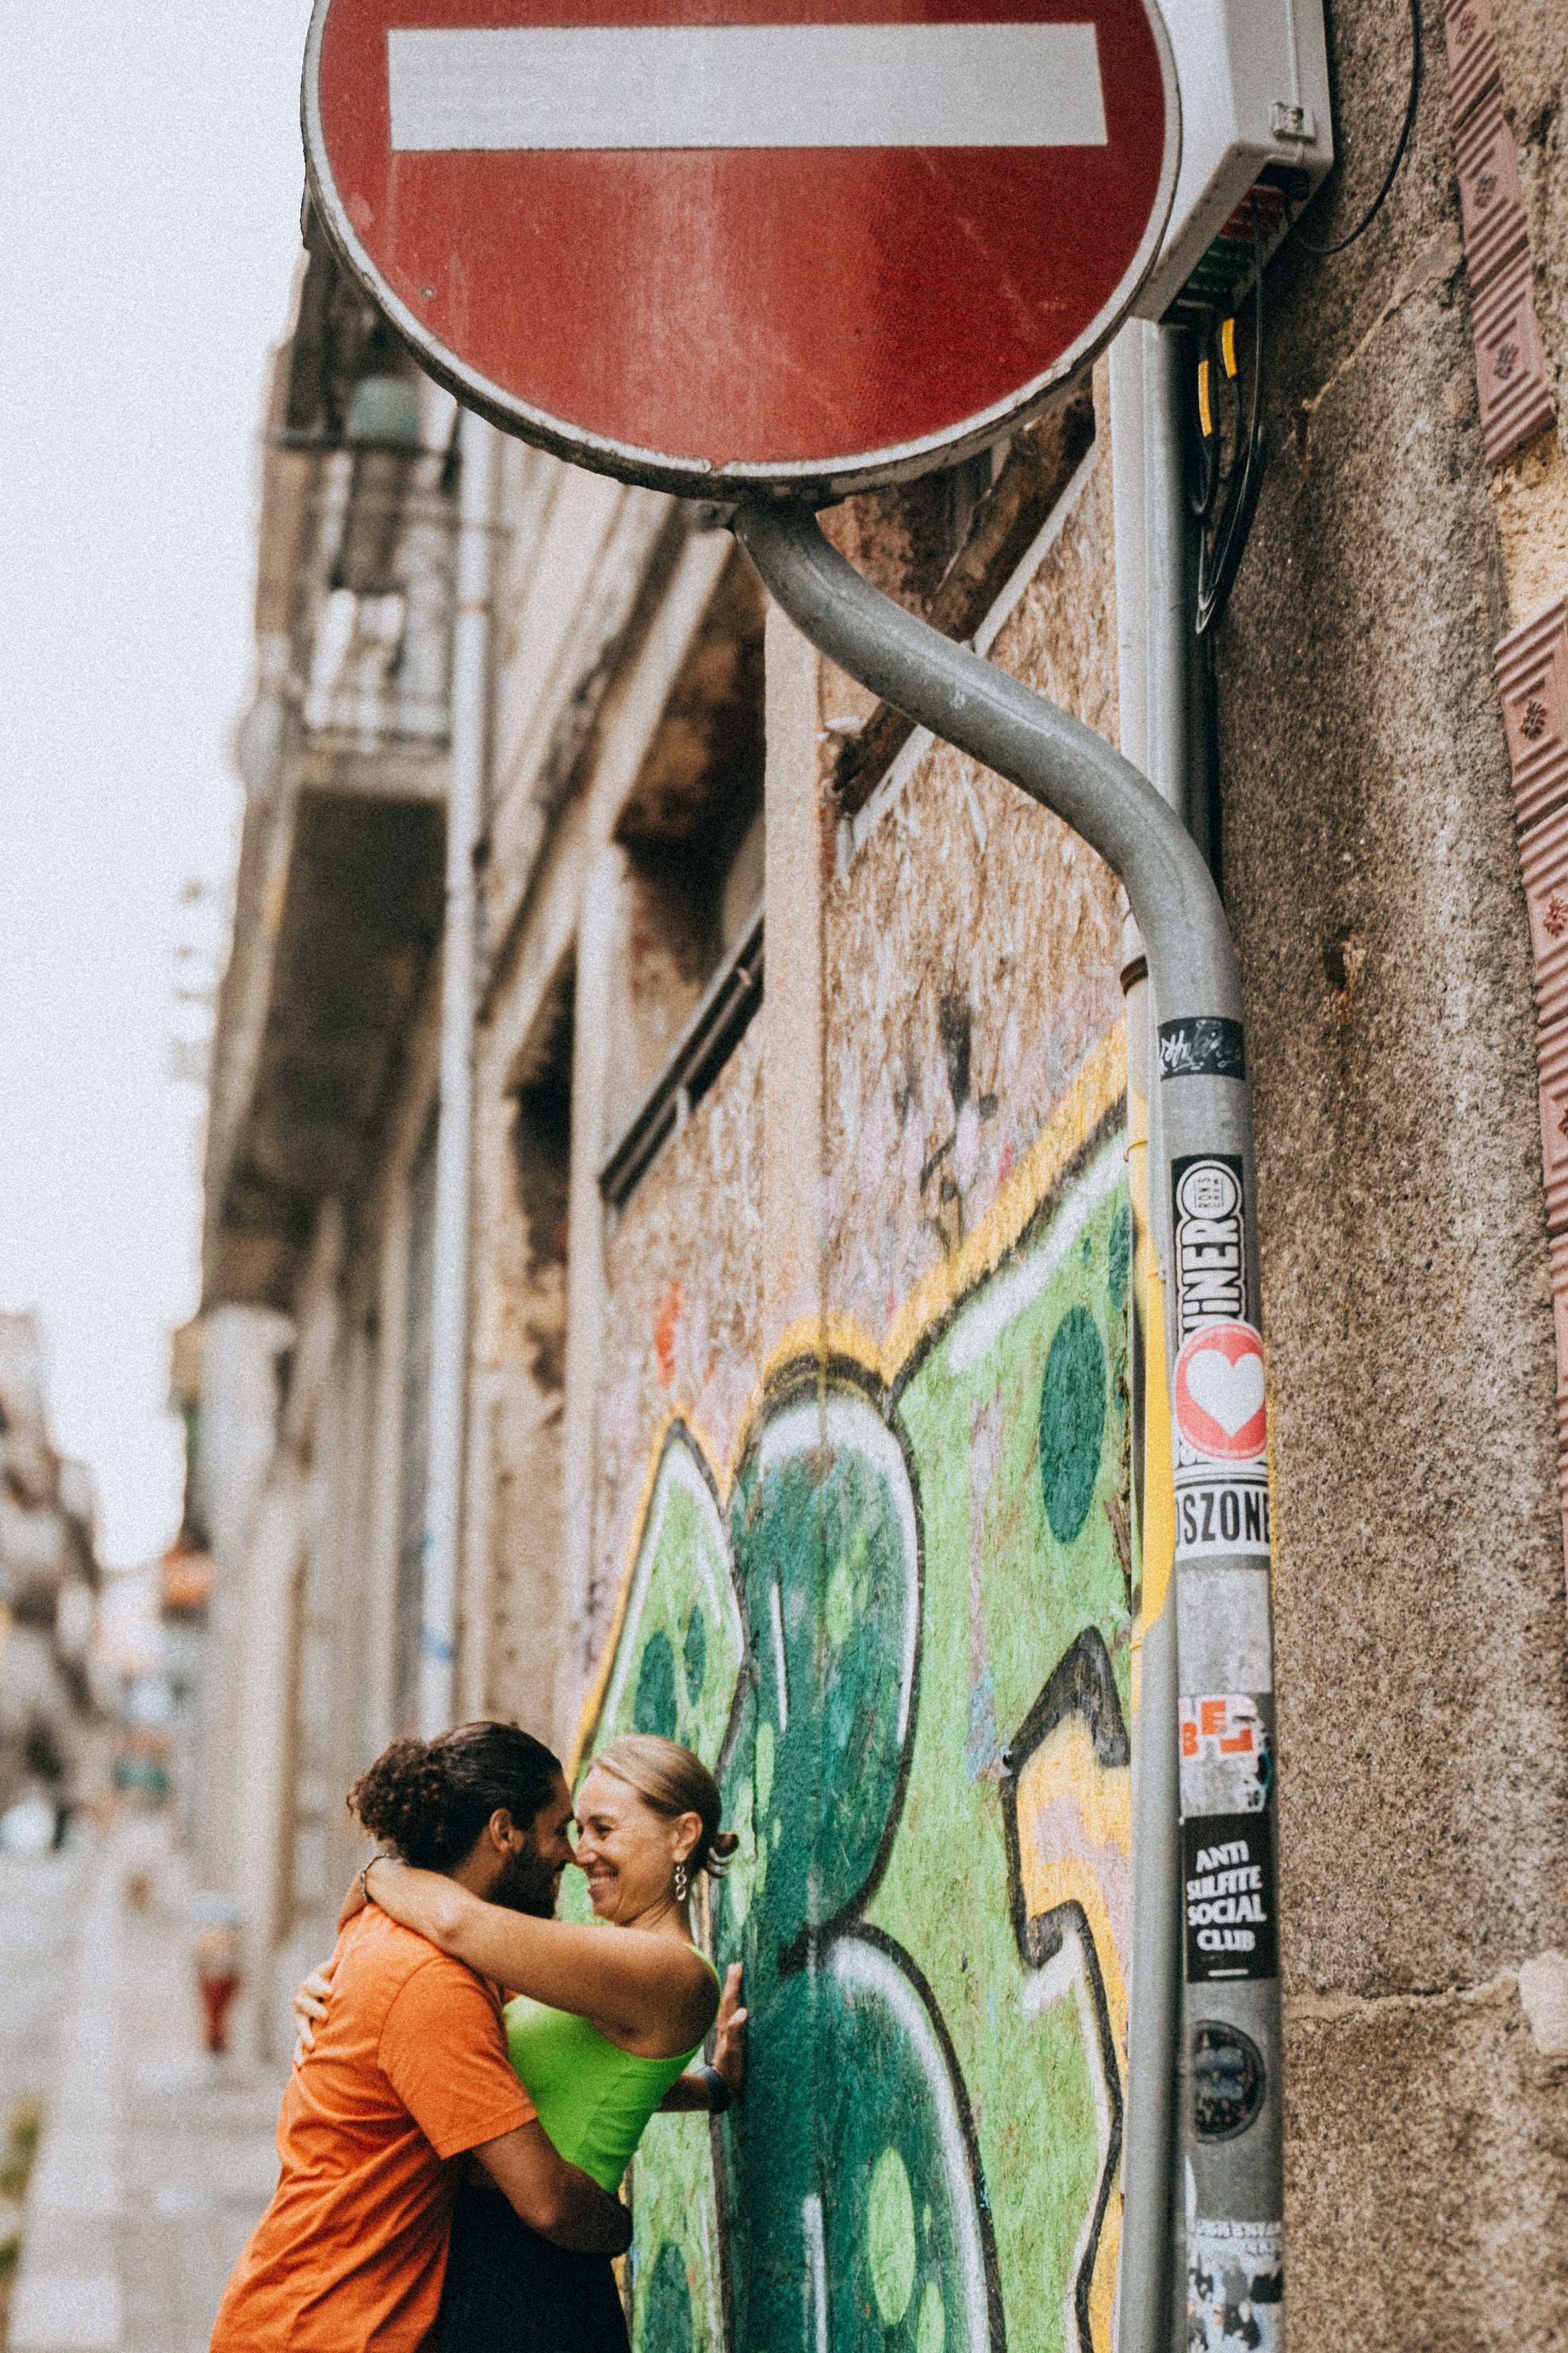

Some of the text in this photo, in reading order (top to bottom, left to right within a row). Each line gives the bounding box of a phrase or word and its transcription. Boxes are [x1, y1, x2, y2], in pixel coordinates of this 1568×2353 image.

[1195, 1840, 1249, 1873] ANTI
[1186, 1865, 1263, 1901] SULFITE
[1187, 1894, 1267, 1926] SOCIAL
[1196, 1929, 1256, 1952] CLUB
